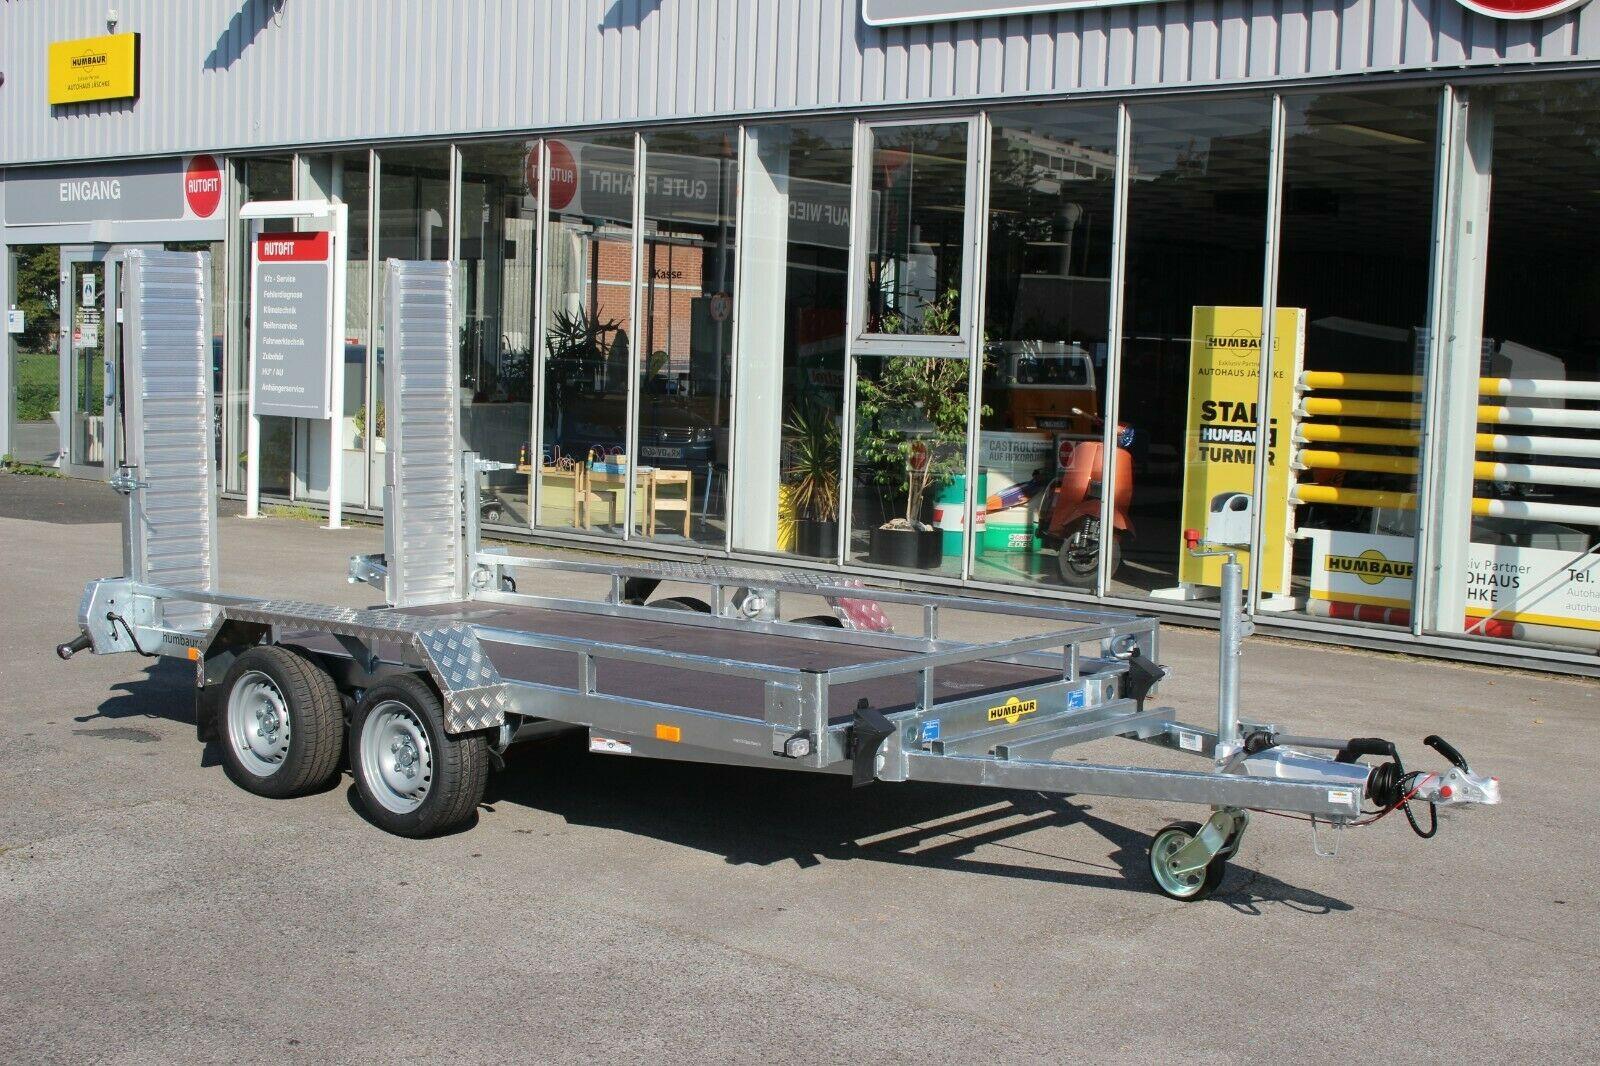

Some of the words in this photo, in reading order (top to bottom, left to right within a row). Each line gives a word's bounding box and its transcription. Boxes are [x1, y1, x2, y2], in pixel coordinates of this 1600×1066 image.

[72, 55, 106, 67] HUMBAUR
[60, 179, 121, 202] EINGANG
[188, 178, 219, 194] AUTOFIT
[264, 242, 294, 256] AUTOFIT
[276, 274, 296, 283] Service
[654, 268, 682, 278] Kasse
[264, 322, 298, 330] Reifenservice
[1198, 368, 1244, 376] AUTOHAUS
[990, 440, 1031, 452] CASTROL
[1484, 560, 1530, 574] Partner
[1568, 568, 1594, 583] Tel.
[990, 702, 1035, 718] HUMBAUR
